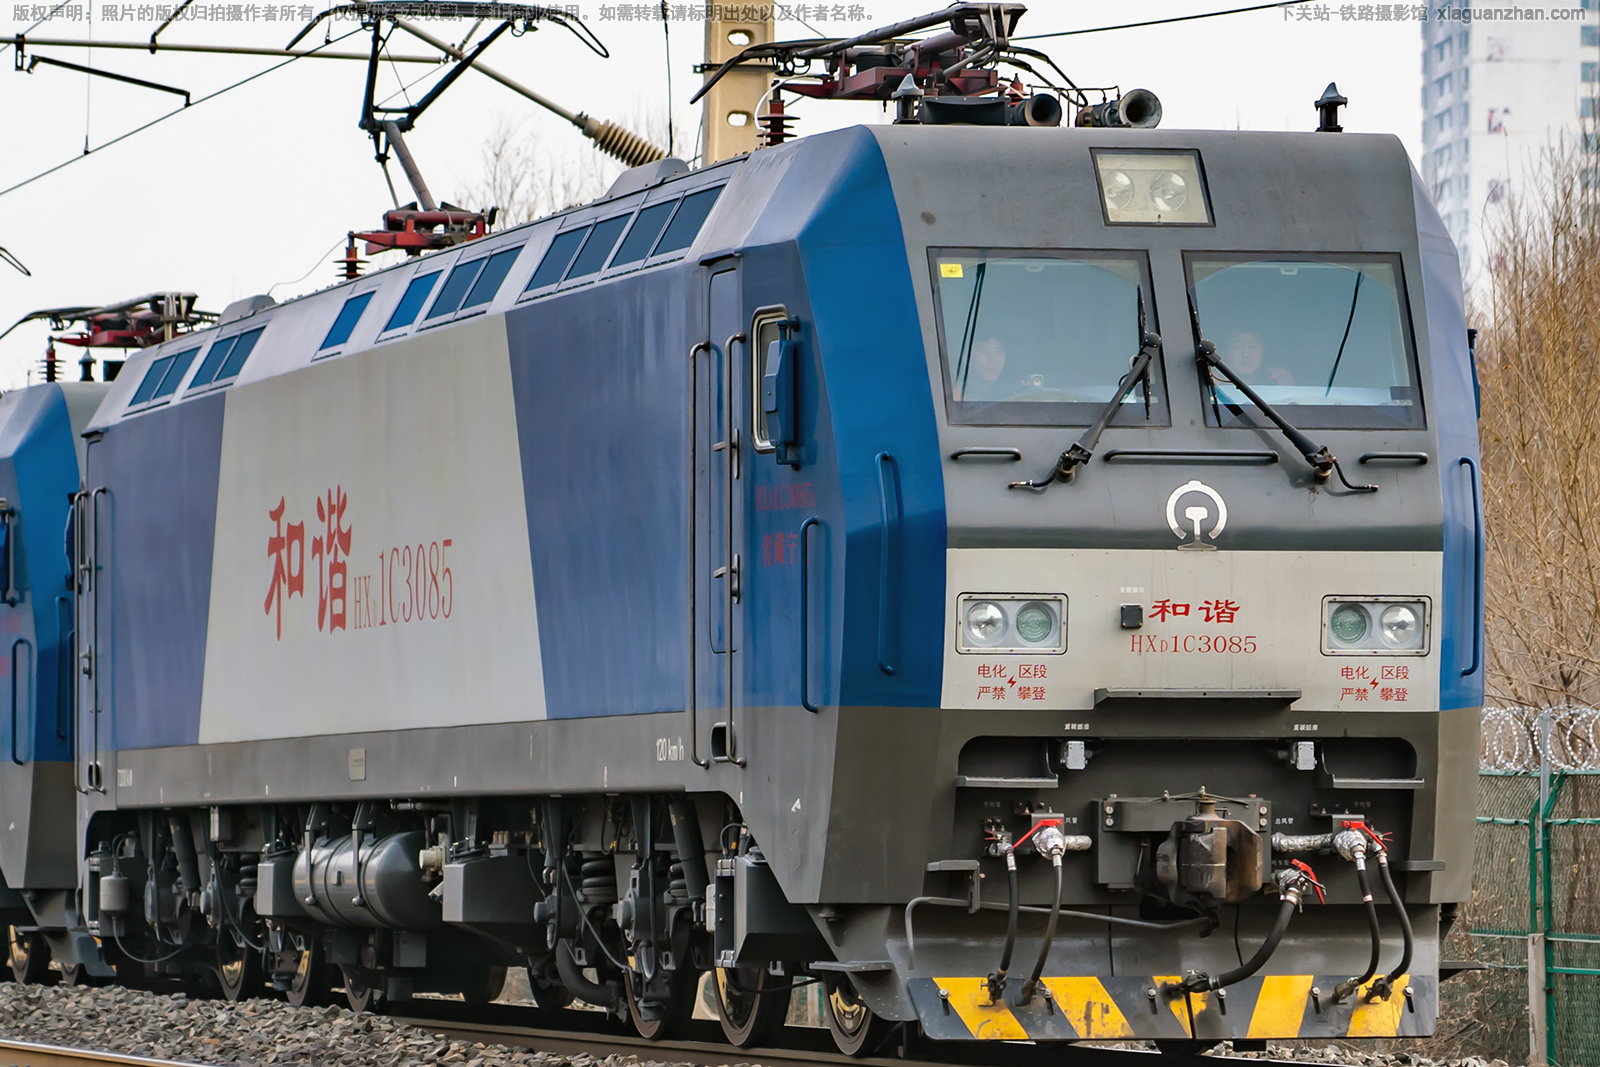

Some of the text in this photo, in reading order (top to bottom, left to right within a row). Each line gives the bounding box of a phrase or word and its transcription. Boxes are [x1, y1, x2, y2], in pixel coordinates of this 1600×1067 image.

[264, 484, 352, 641] 和谐
[1148, 598, 1241, 624] 和谐
[1130, 634, 1257, 655] HXD1C3085
[977, 664, 1047, 679] 电化 区段
[1340, 665, 1409, 680] 电化 区段
[976, 686, 1046, 701] 严禁 攀登
[1339, 687, 1408, 702] 严禁 攀登
[656, 738, 667, 762] 120
